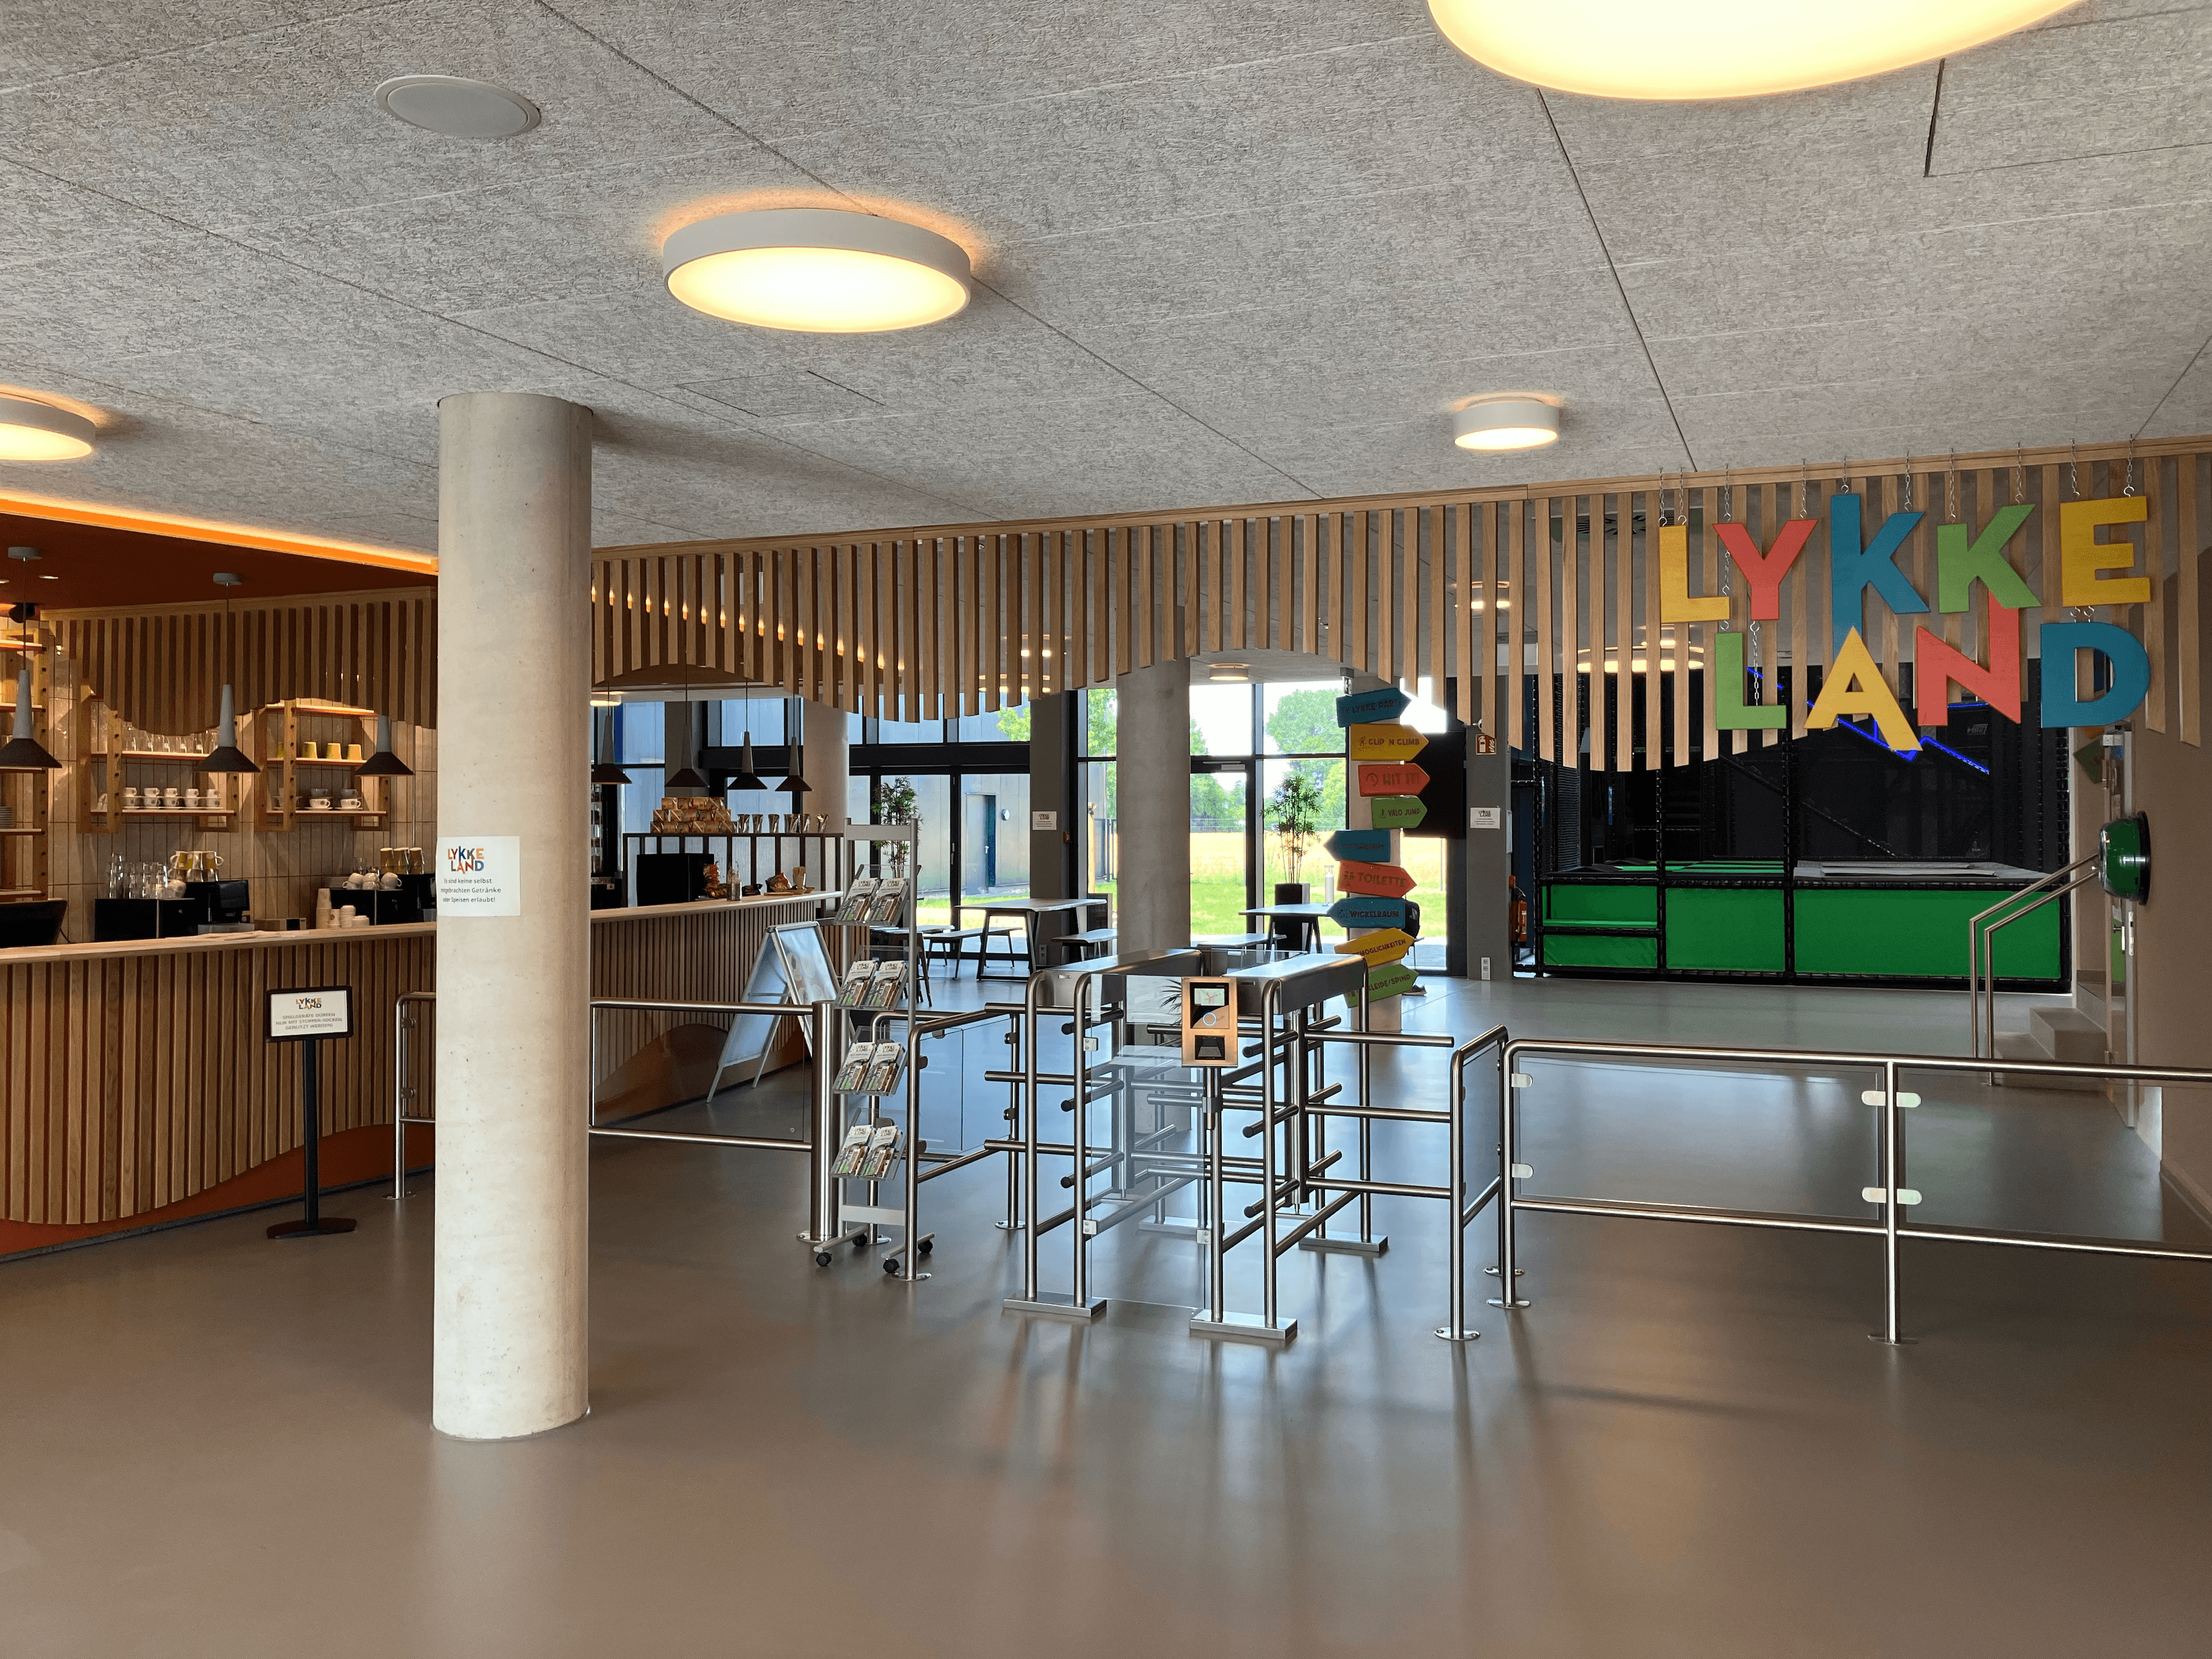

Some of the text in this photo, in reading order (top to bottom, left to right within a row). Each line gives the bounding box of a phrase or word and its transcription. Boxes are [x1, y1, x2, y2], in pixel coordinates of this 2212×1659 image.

[1660, 493, 2150, 661] LYKKE
[1715, 592, 2150, 751] LAND
[1388, 808, 1421, 817] VALO JUMP
[448, 846, 484, 861] LYKKE
[451, 859, 484, 874] LAND
[1357, 872, 1406, 888] TOILETTE
